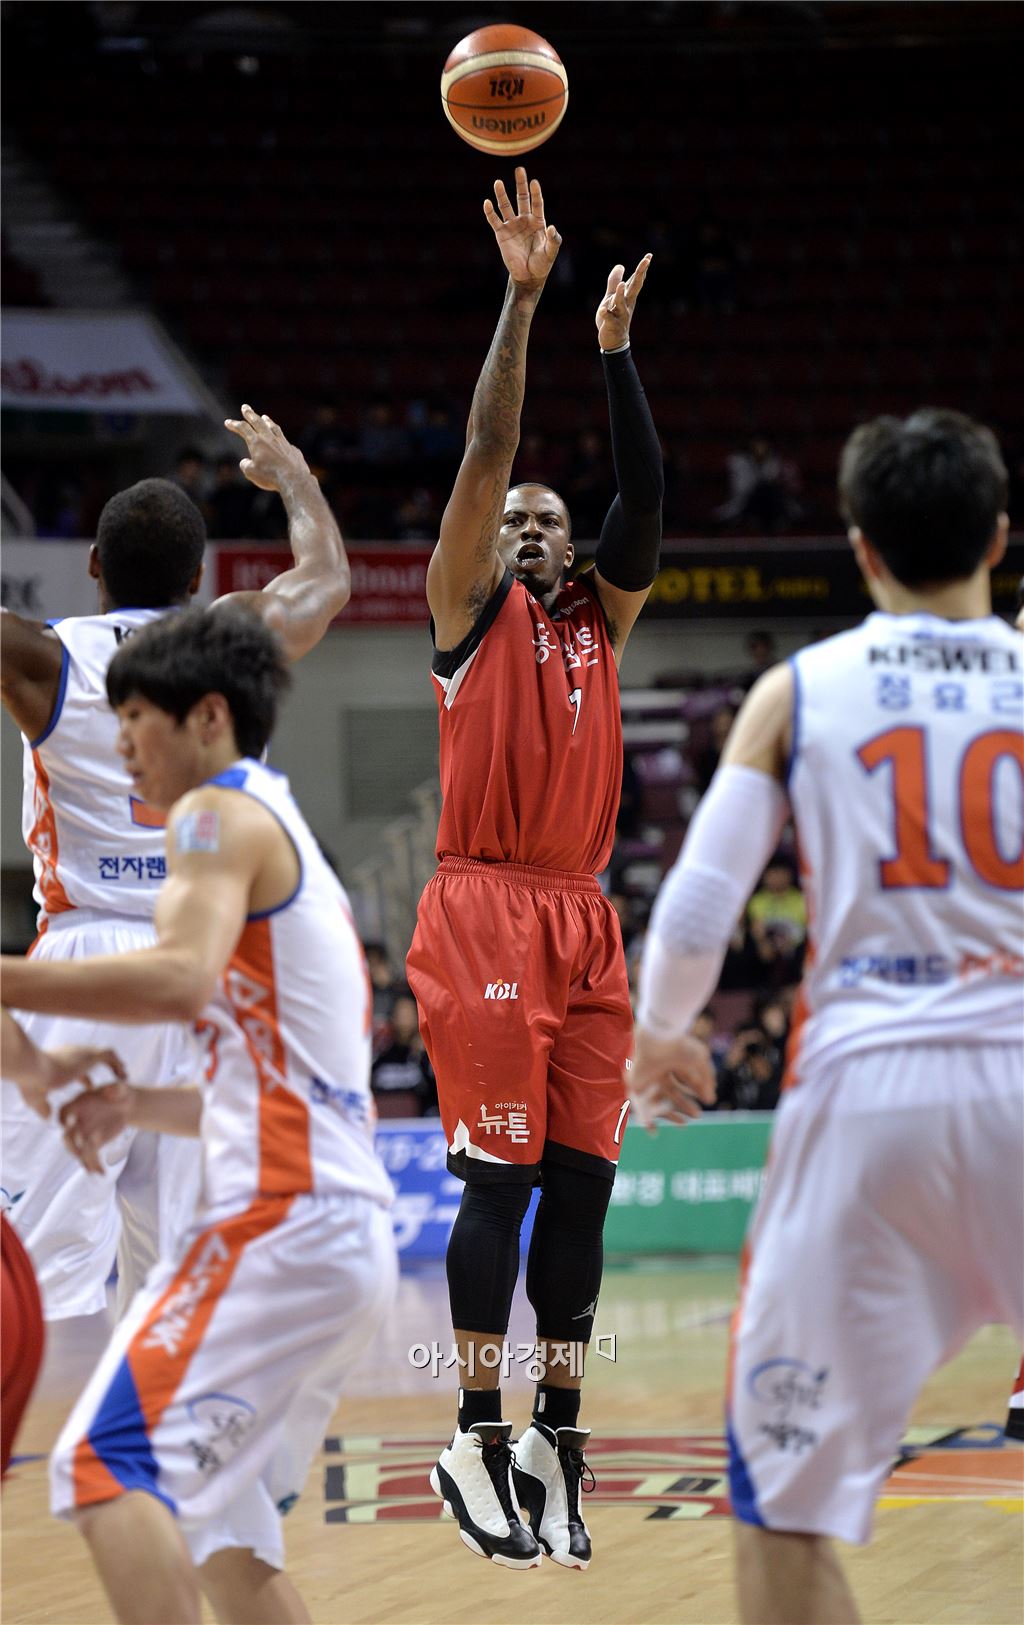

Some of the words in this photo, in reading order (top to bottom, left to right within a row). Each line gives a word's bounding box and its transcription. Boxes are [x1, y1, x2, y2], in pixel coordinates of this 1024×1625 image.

[471, 111, 545, 134] molten
[856, 724, 1024, 890] 10
[99, 856, 167, 880] 전자랜
[484, 979, 519, 1000] KBL
